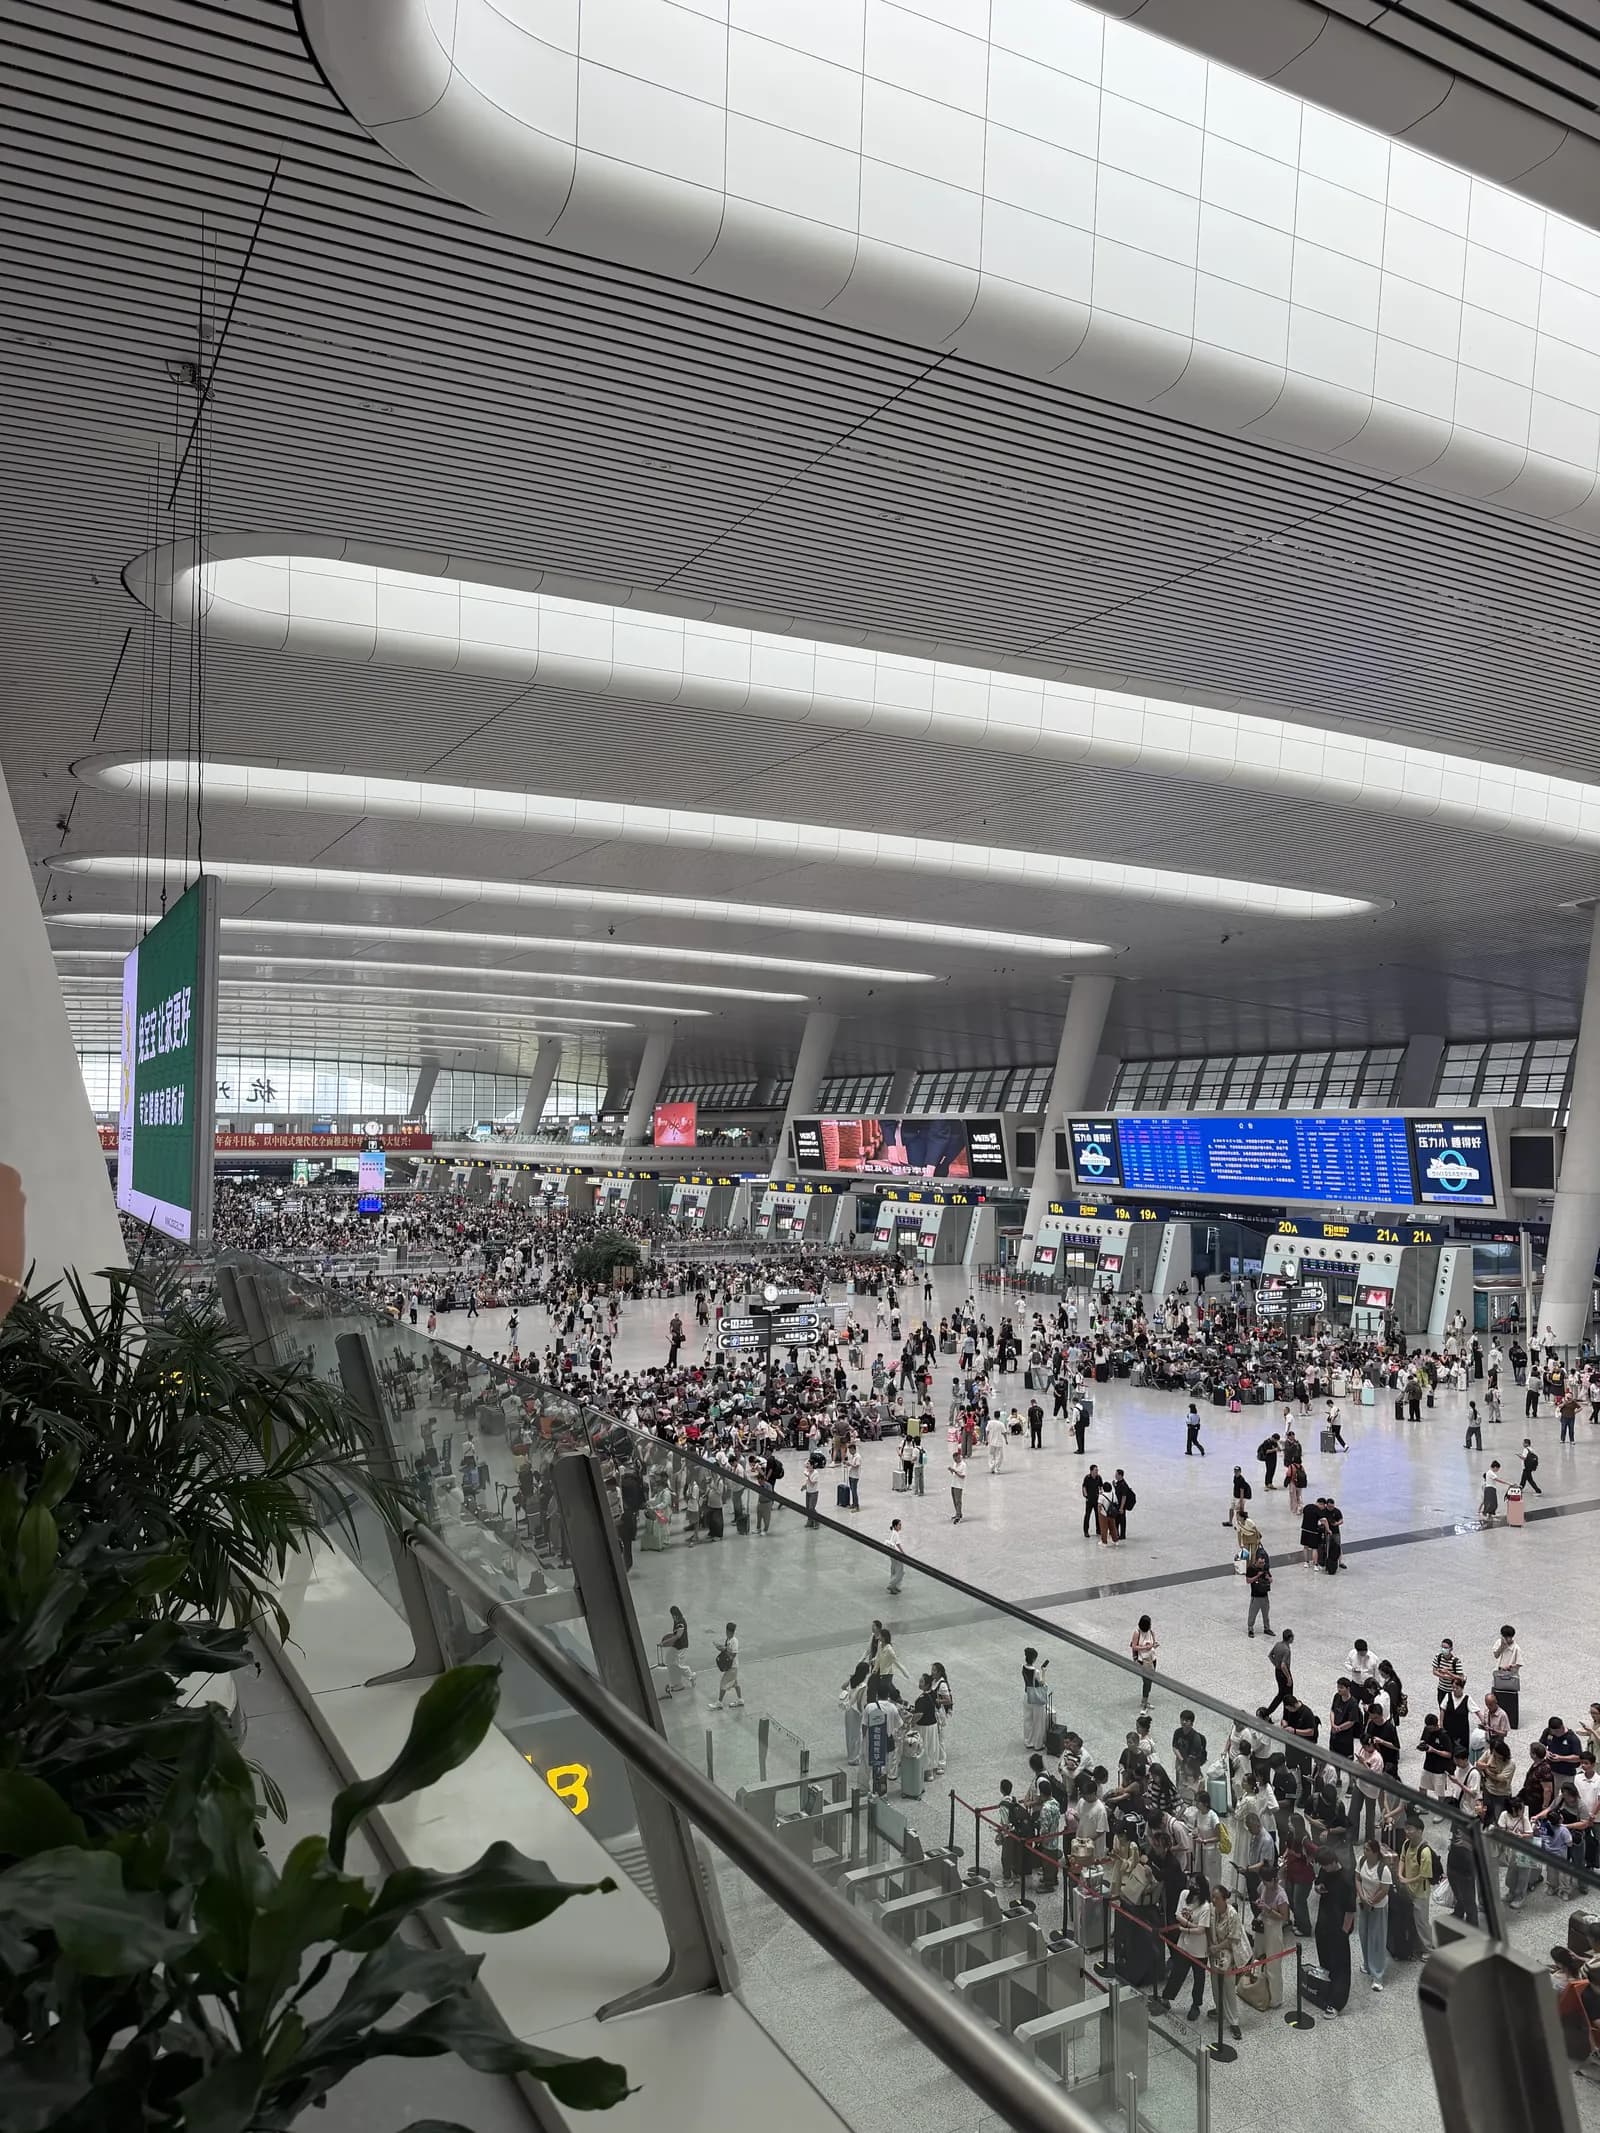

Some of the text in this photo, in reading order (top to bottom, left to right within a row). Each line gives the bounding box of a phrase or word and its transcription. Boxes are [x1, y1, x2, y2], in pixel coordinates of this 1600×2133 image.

[158, 986, 191, 1054] 让家更好
[1418, 1136, 1449, 1149] 压力小
[819, 1184, 833, 1193] 15A
[933, 1194, 945, 1204] 17A
[952, 1195, 967, 1204] 17A
[1050, 1203, 1063, 1213] 18A
[1115, 1208, 1130, 1219] 19A
[1140, 1209, 1157, 1220] 19A
[1278, 1221, 1298, 1233] 20A
[1377, 1229, 1399, 1242] 21A
[1413, 1230, 1432, 1243] 21A
[524, 1752, 590, 1816] B
